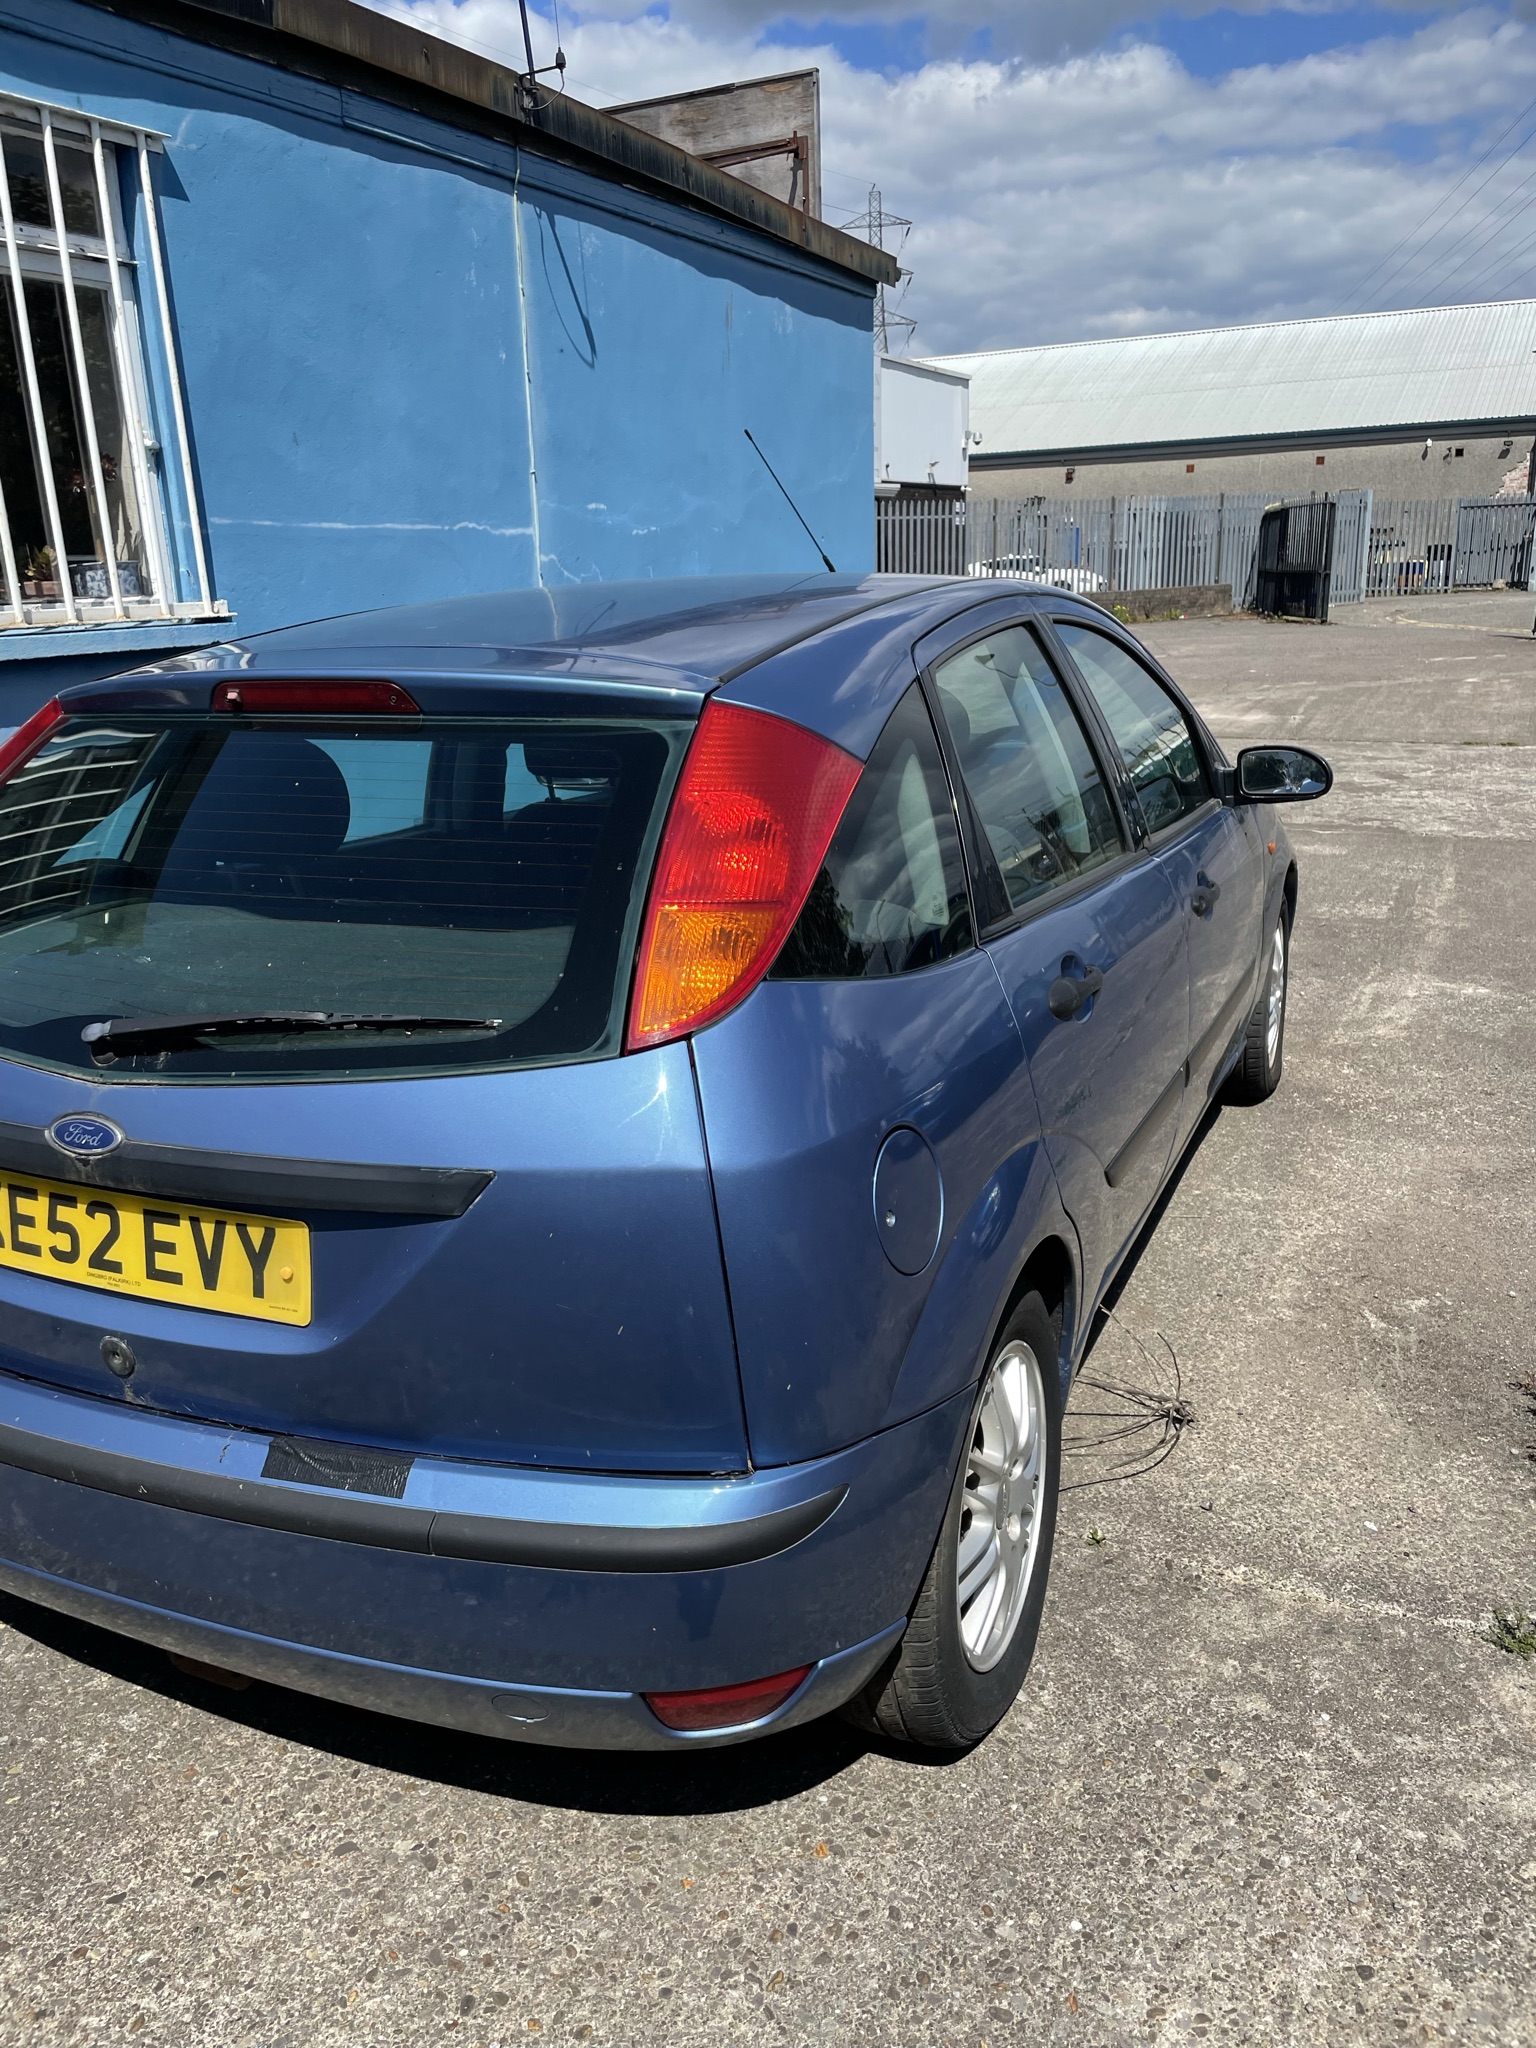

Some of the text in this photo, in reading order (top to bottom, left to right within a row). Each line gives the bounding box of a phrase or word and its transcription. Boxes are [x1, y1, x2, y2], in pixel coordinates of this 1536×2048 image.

[64, 1123, 103, 1146] Ford
[0, 1183, 277, 1299] E52 EVY
